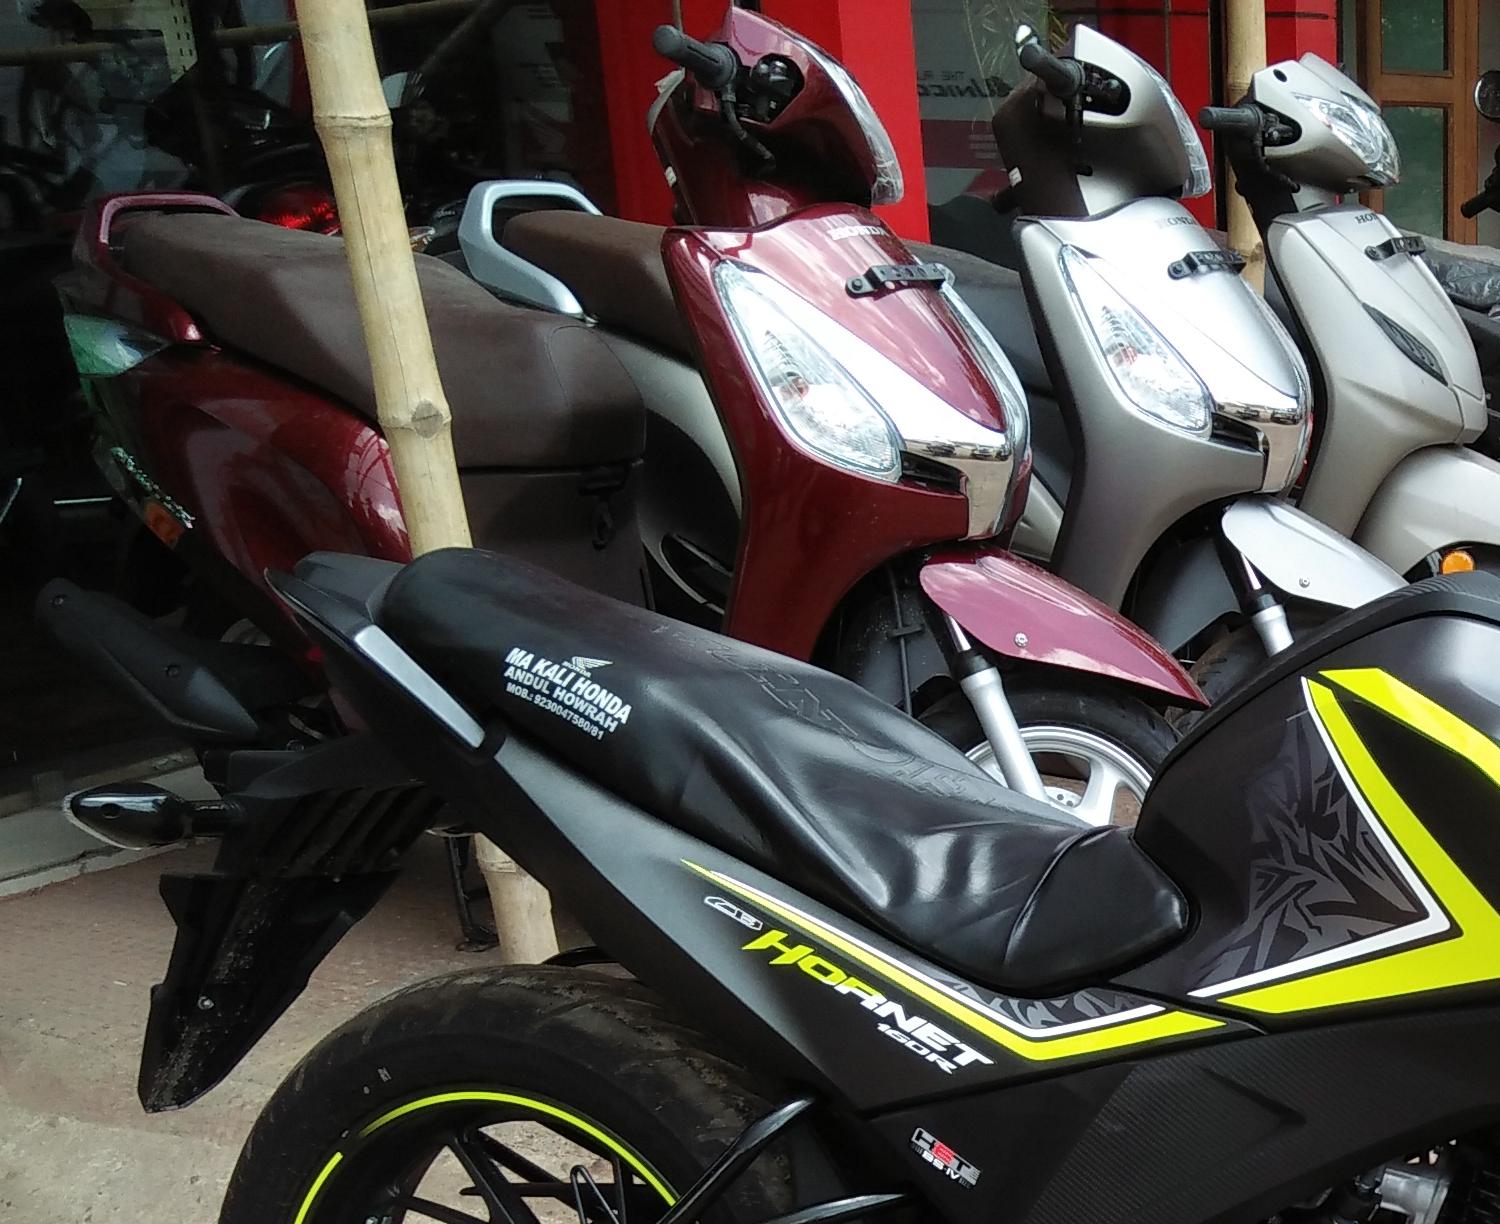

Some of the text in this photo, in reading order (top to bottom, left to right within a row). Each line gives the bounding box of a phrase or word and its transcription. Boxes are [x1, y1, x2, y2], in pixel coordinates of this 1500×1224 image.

[504, 648, 632, 724] MA KALI HONDA
[504, 666, 618, 732] ANDUL HOWRAH
[742, 929, 995, 1066] HORNET
[876, 1022, 954, 1074] 160R
